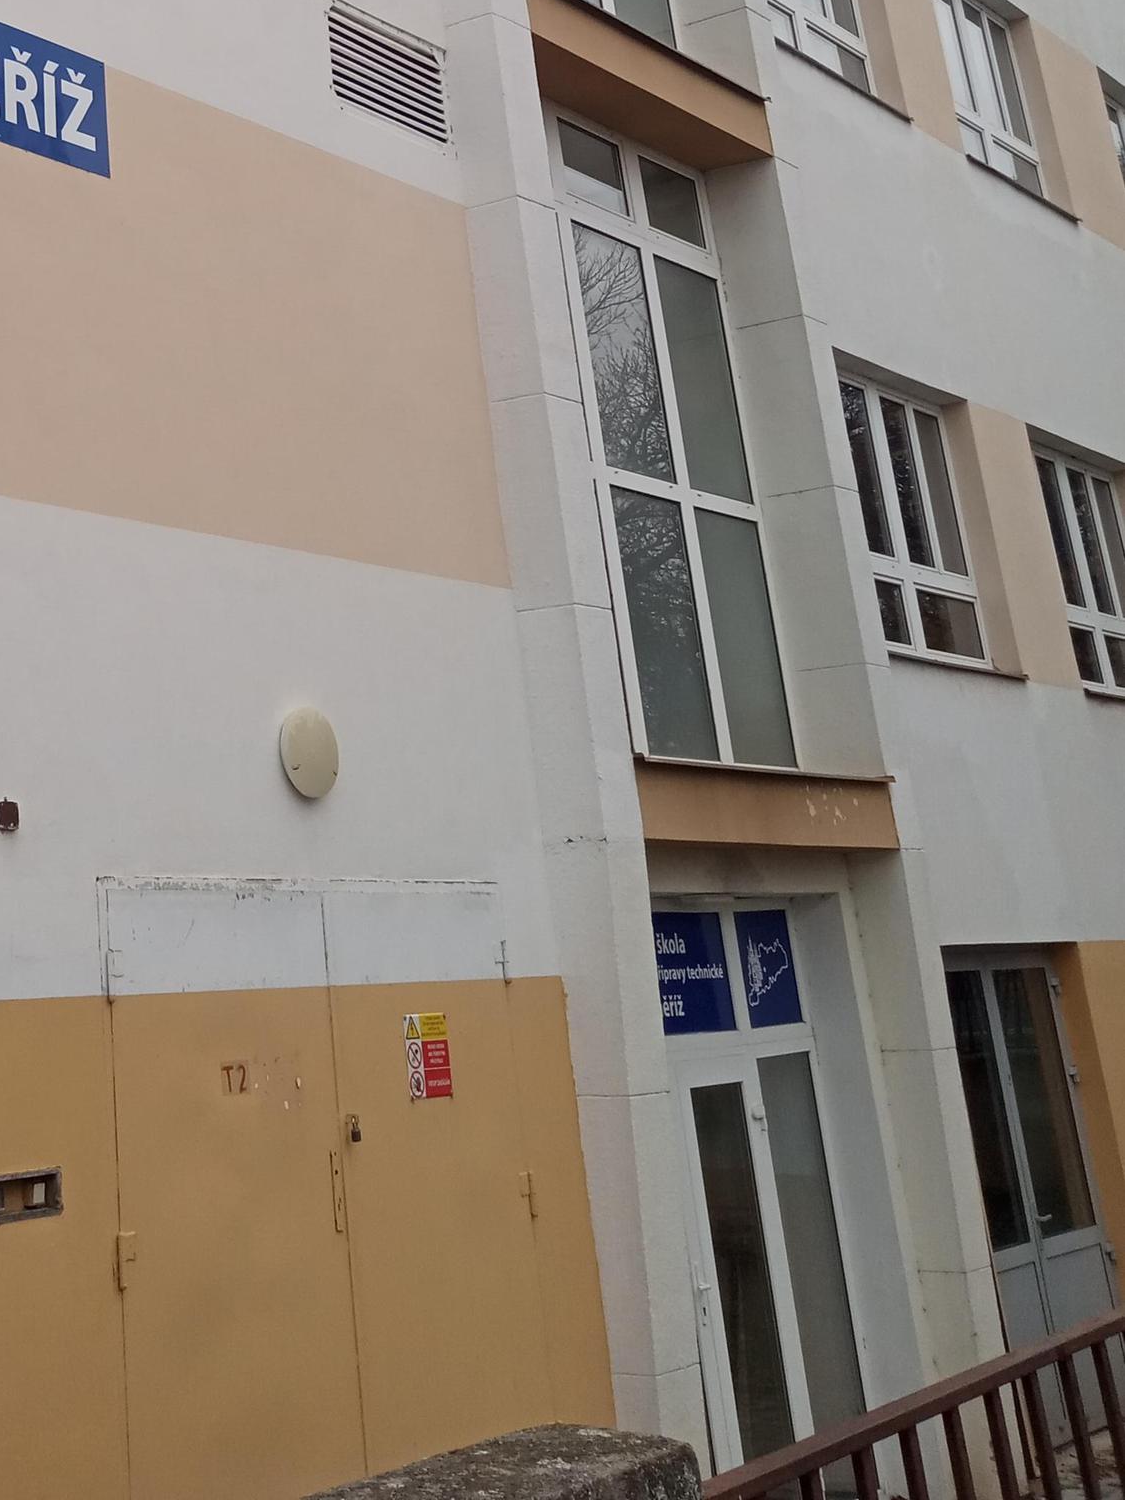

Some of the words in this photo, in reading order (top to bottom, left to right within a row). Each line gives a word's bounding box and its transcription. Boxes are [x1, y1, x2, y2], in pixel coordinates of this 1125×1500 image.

[656, 933, 686, 955] škola
[686, 963, 724, 980] technické
[221, 1065, 247, 1094] T2
